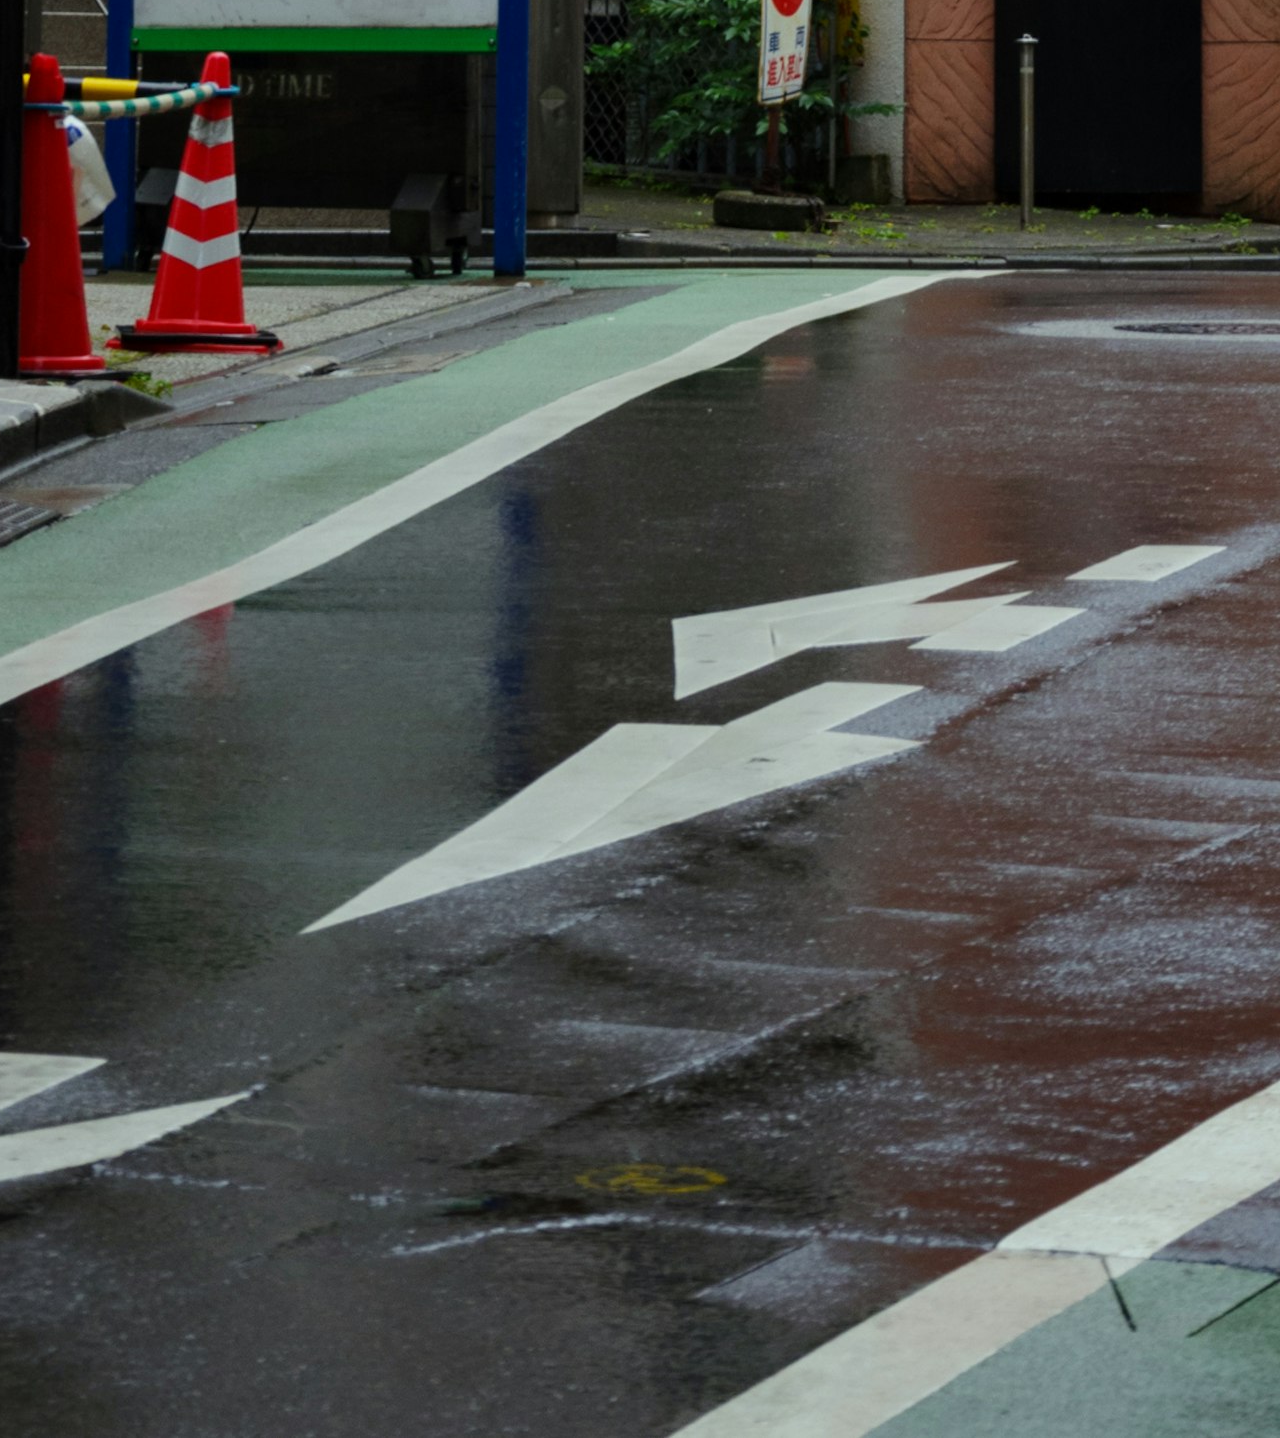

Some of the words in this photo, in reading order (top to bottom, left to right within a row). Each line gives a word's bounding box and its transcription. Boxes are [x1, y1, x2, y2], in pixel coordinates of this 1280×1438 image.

[766, 52, 802, 87] 進入禁止
[260, 73, 332, 98] TIME
